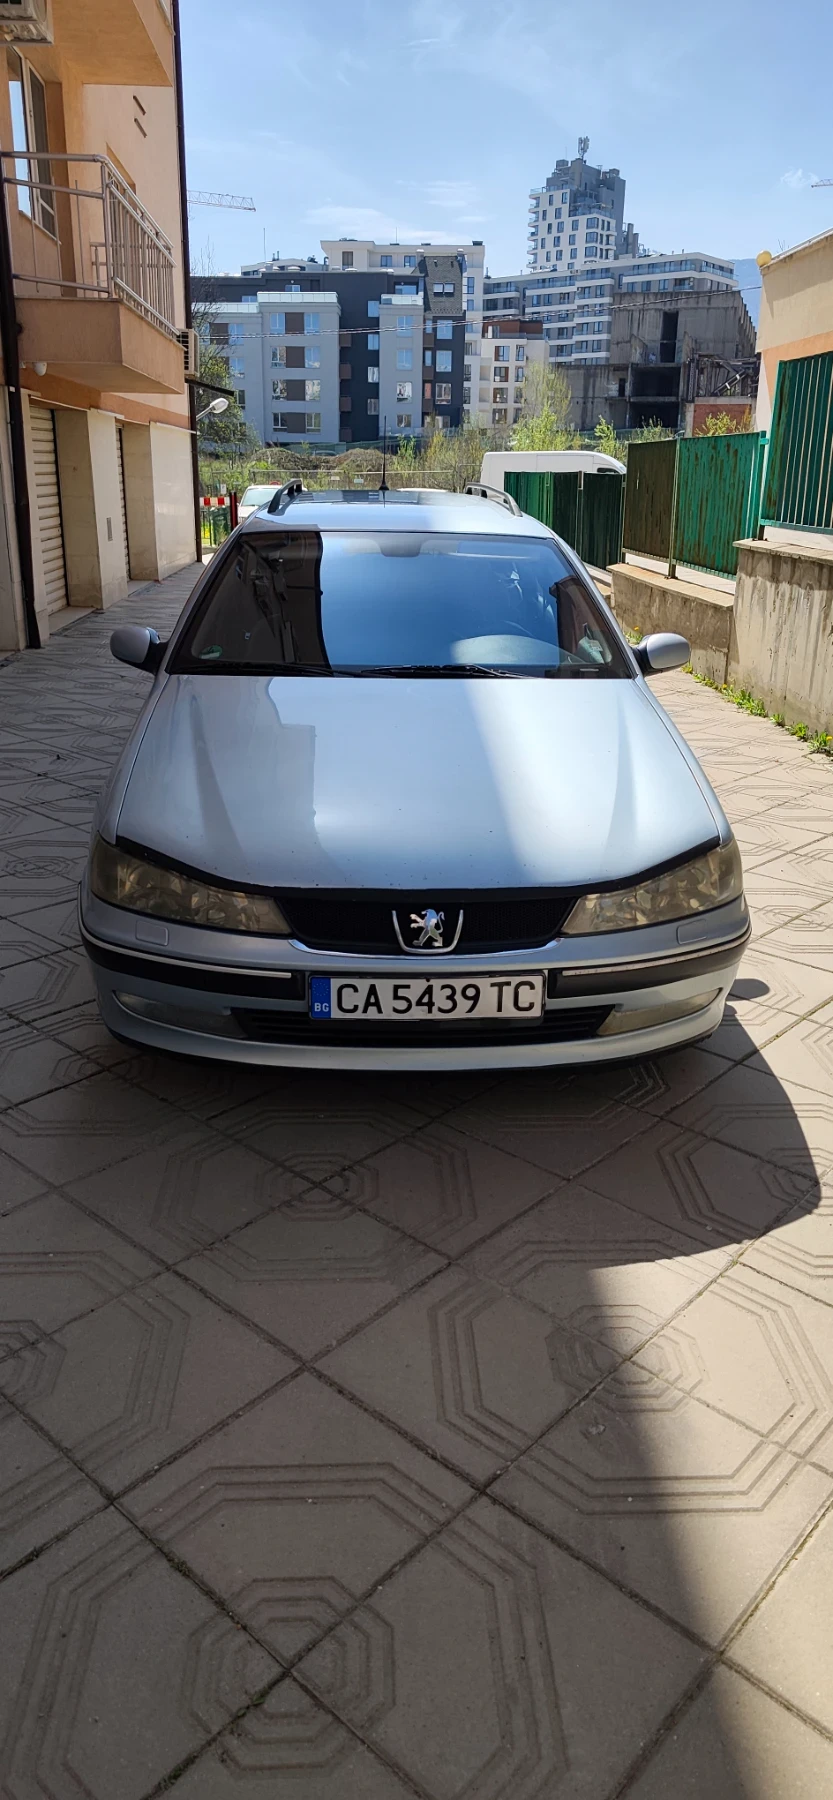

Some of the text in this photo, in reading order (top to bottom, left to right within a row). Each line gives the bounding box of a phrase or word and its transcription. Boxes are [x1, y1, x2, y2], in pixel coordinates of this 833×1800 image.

[314, 1002, 329, 1012] BG
[336, 980, 536, 1014] CA 5439 TC
